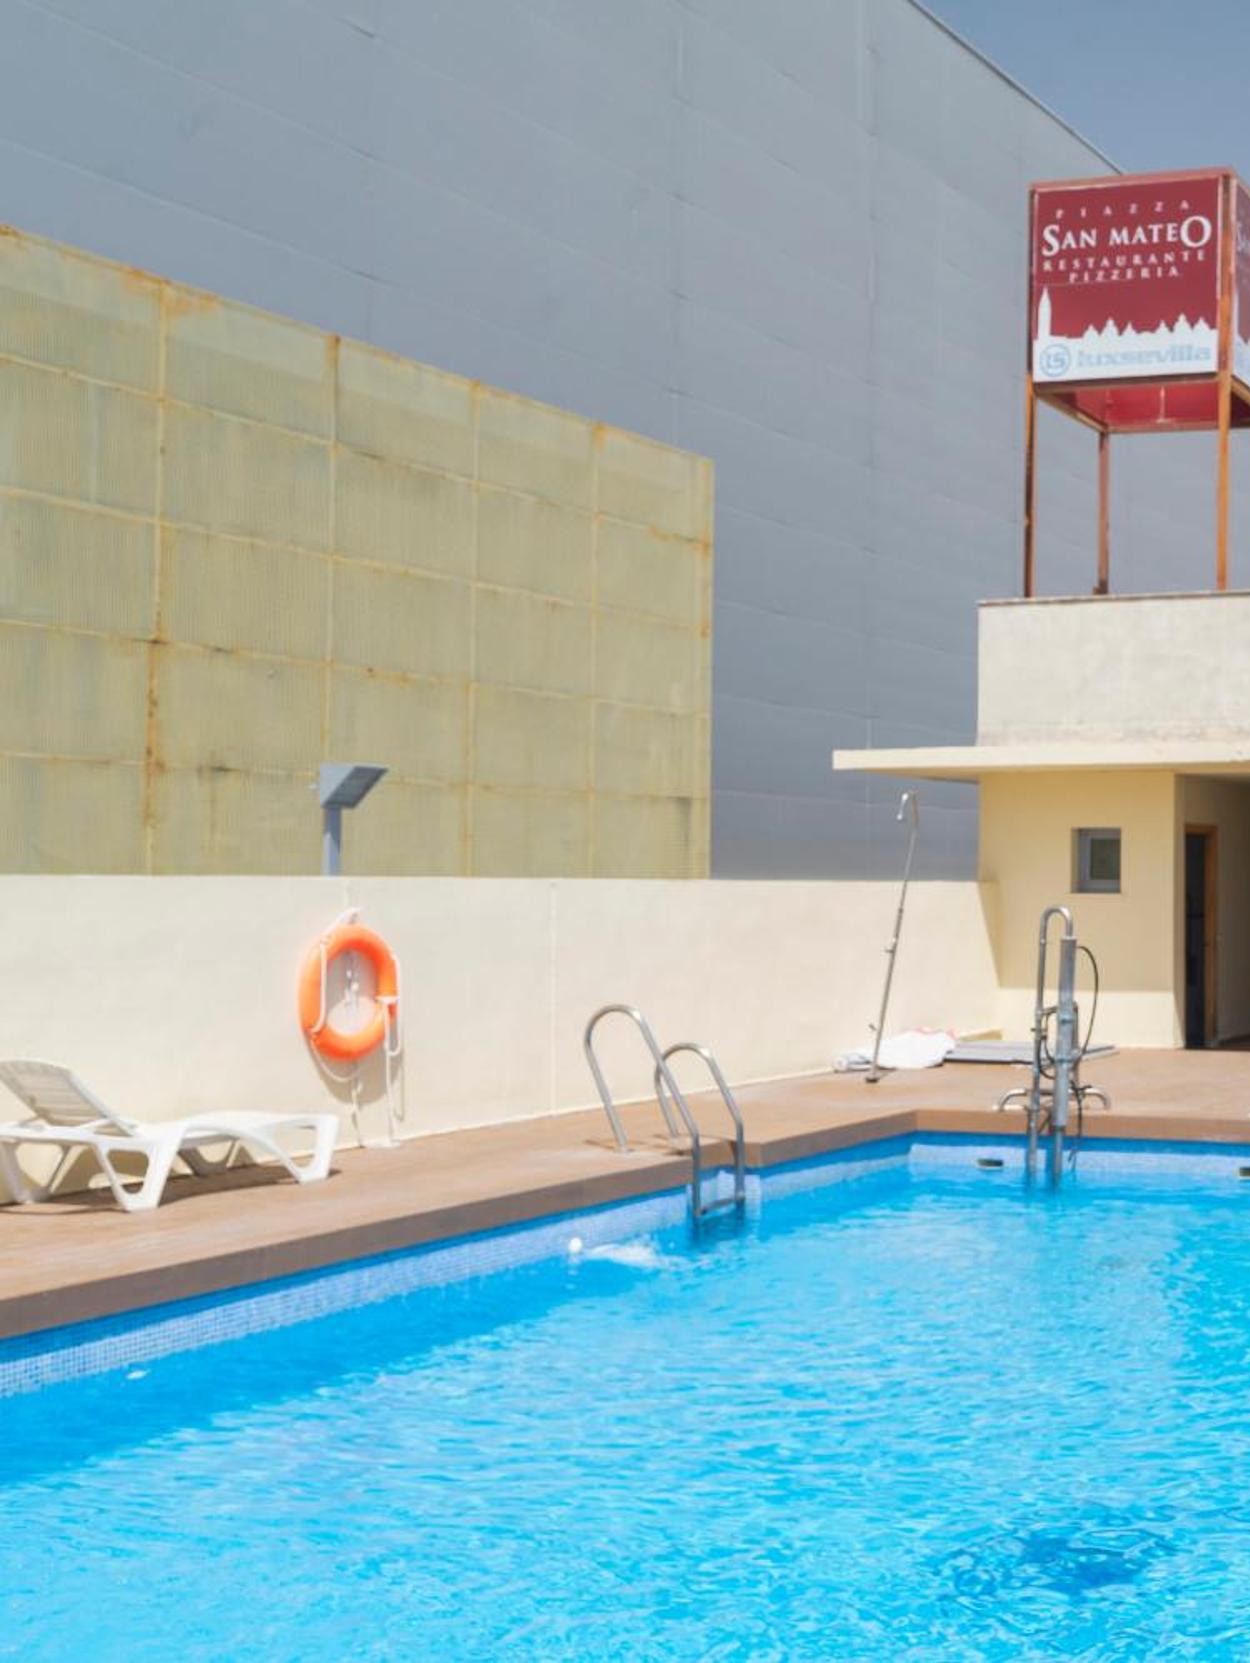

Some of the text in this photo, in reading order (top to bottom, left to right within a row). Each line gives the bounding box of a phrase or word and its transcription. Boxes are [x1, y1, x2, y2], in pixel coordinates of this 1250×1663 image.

[1055, 199, 1190, 220] PIAZZA
[1041, 224, 1098, 257] SAN
[1109, 215, 1213, 248] MATEO
[1042, 250, 1205, 272] RESTAURANTE
[1068, 265, 1180, 284] PIZZERIA
